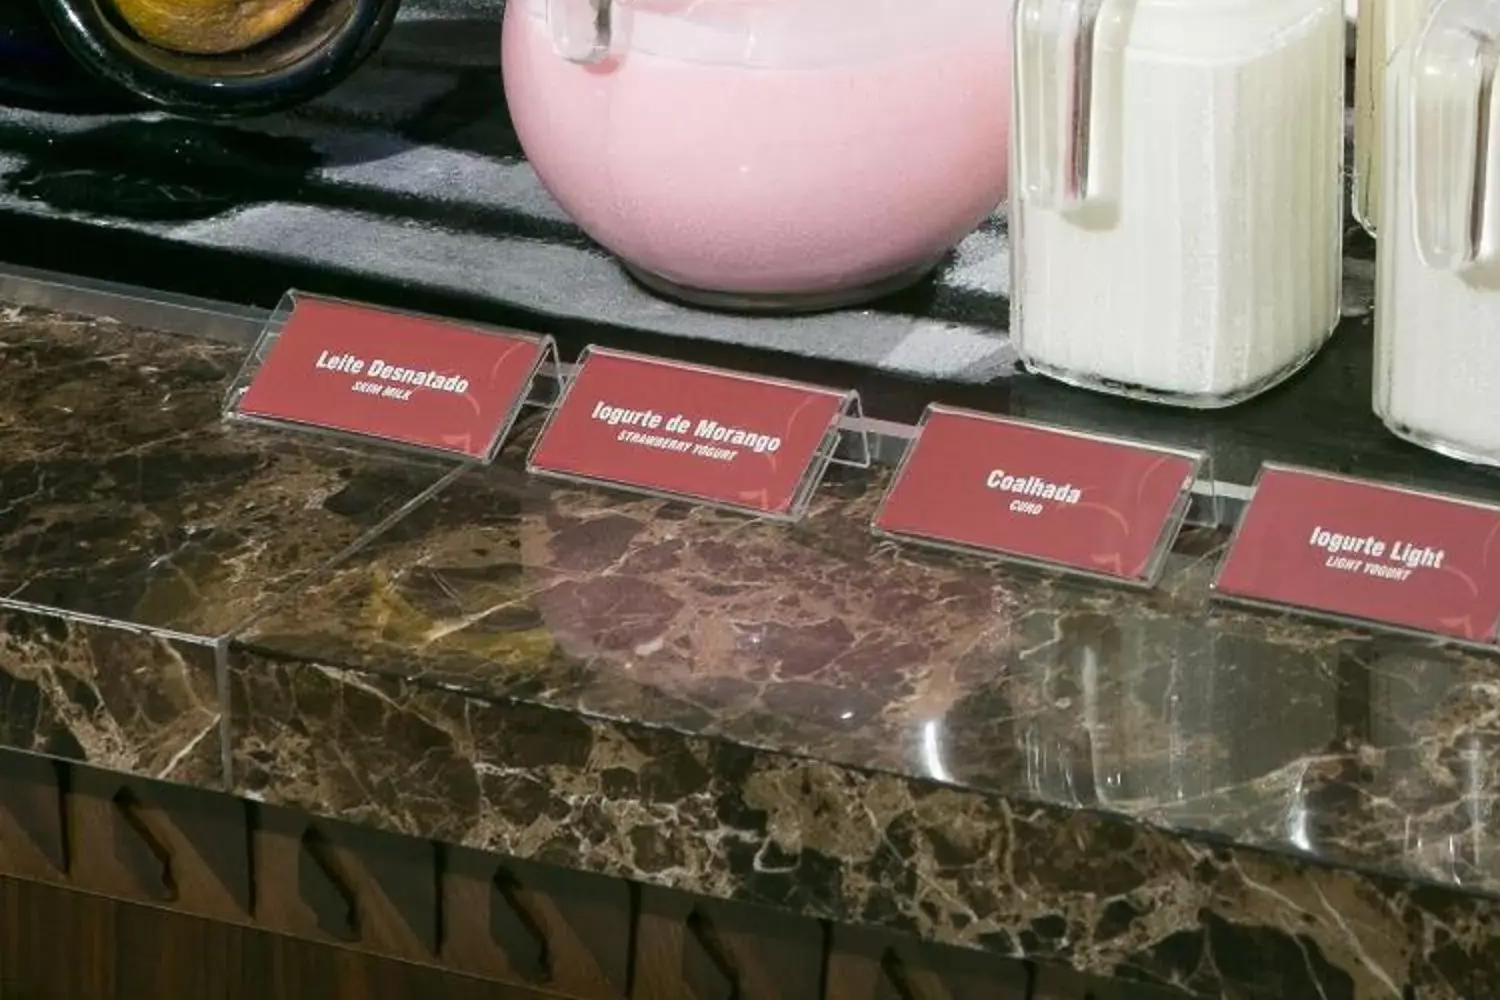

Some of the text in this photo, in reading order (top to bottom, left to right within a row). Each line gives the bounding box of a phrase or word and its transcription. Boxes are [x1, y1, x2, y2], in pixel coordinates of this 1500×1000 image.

[316, 350, 469, 394] Leite Desnatado
[382, 385, 413, 401] MILK
[591, 400, 781, 453] Iogurte de Morango
[617, 430, 738, 461] STRAWBERRY YOGURT
[987, 469, 1082, 504] Coalhada
[1309, 526, 1445, 569] Iogurte Light
[1325, 556, 1412, 581] LIGHT YOGURT
